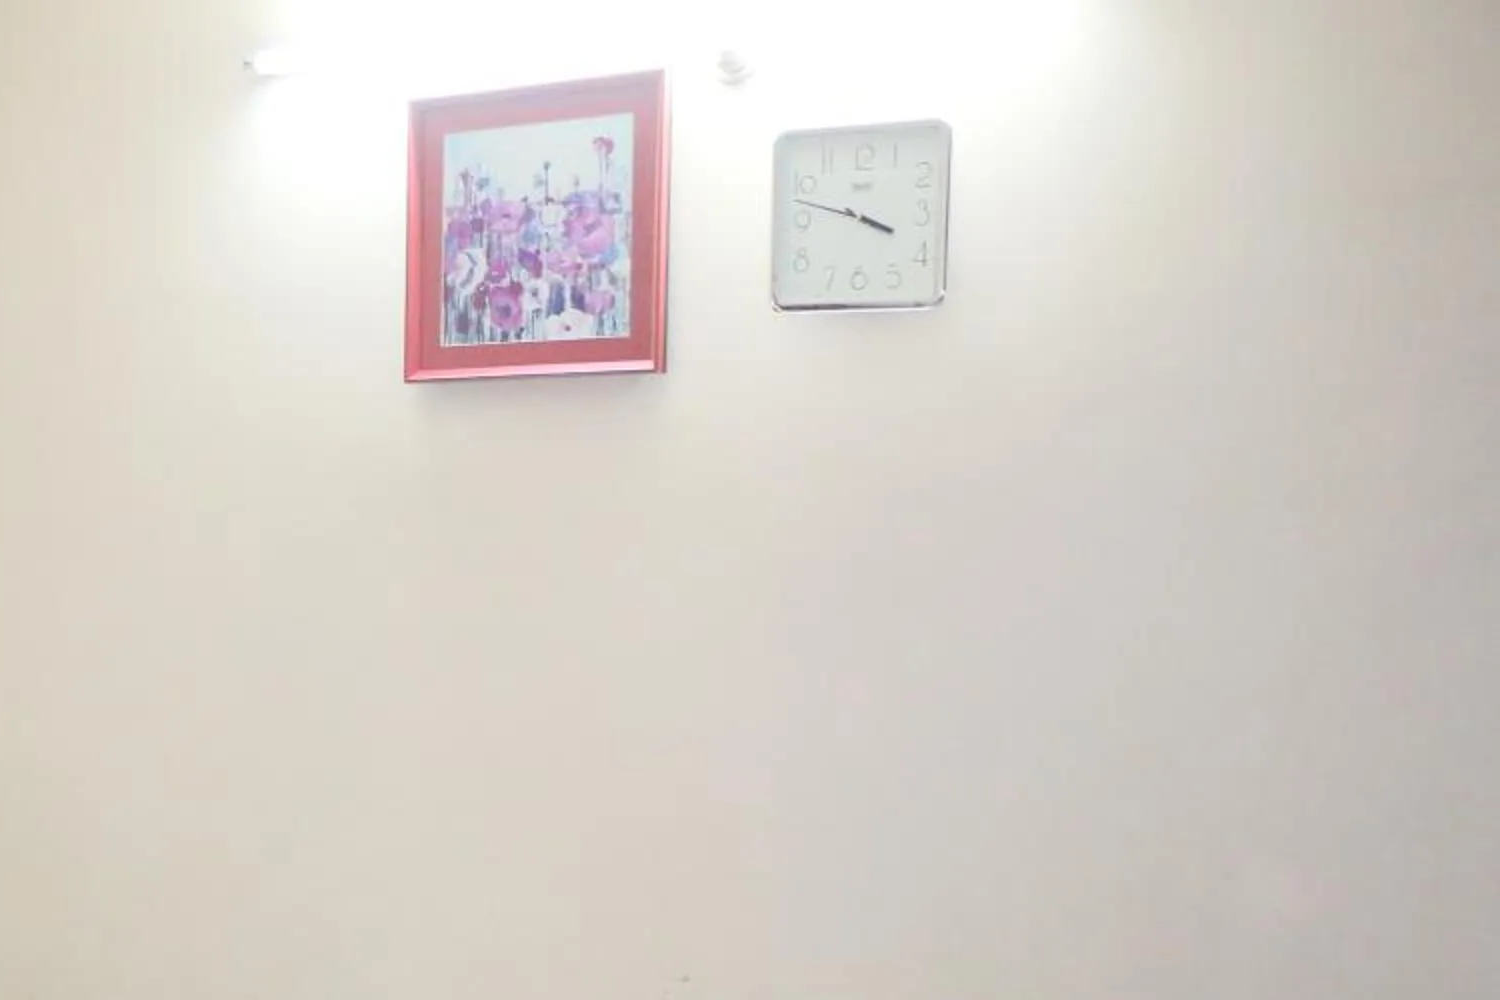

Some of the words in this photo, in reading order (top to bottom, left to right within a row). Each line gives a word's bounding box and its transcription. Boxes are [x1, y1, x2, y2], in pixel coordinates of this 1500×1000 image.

[820, 143, 834, 175] 11
[794, 170, 818, 196] 10
[914, 161, 933, 189] 2
[794, 208, 812, 233] 9
[913, 199, 931, 227] 3
[793, 247, 811, 273] 8
[912, 240, 928, 267] 4
[823, 265, 838, 291] 7
[849, 264, 871, 291] 6
